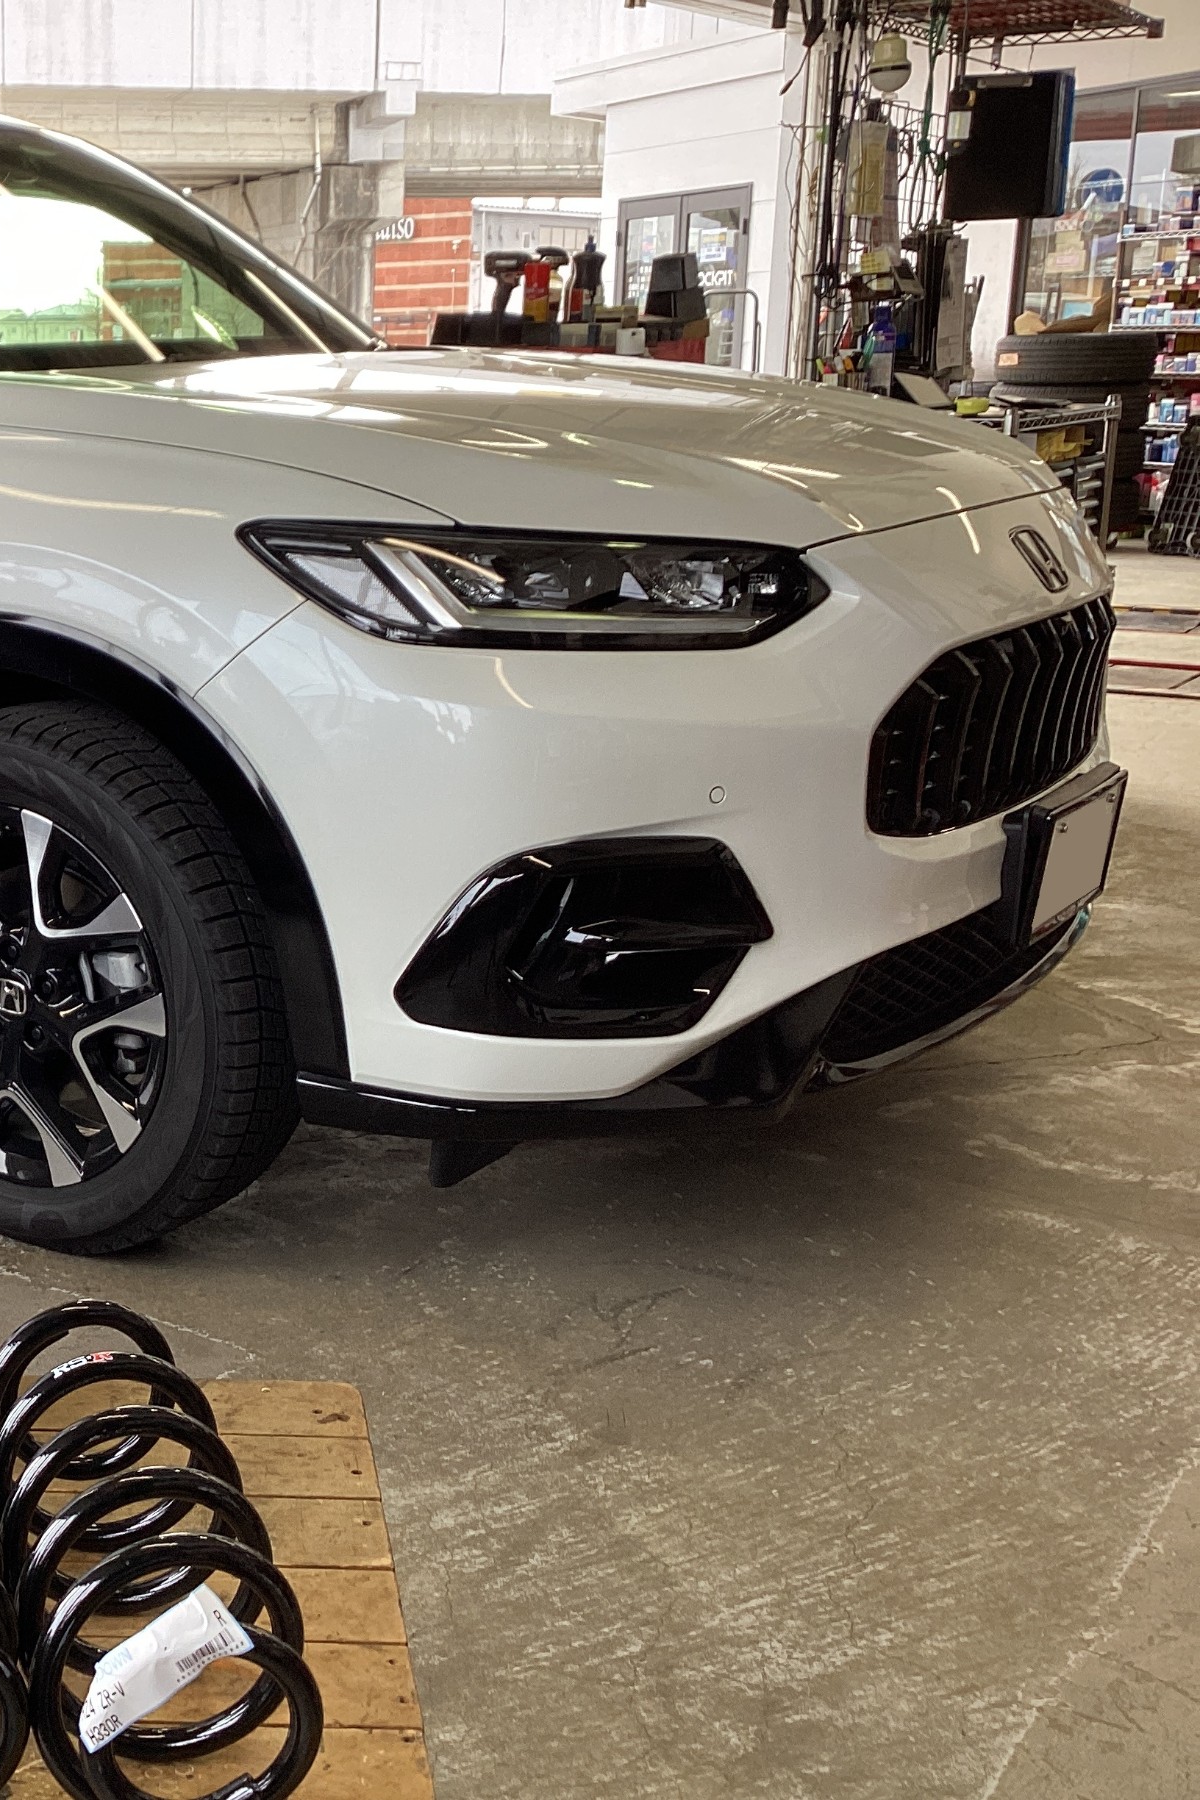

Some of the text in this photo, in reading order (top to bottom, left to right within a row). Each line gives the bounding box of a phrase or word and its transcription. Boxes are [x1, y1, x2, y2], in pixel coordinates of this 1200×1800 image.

[698, 269, 734, 287] OCKPIT
[213, 1609, 227, 1627] R
[97, 1681, 125, 1710] ZR-V
[86, 1714, 123, 1746] H330R
